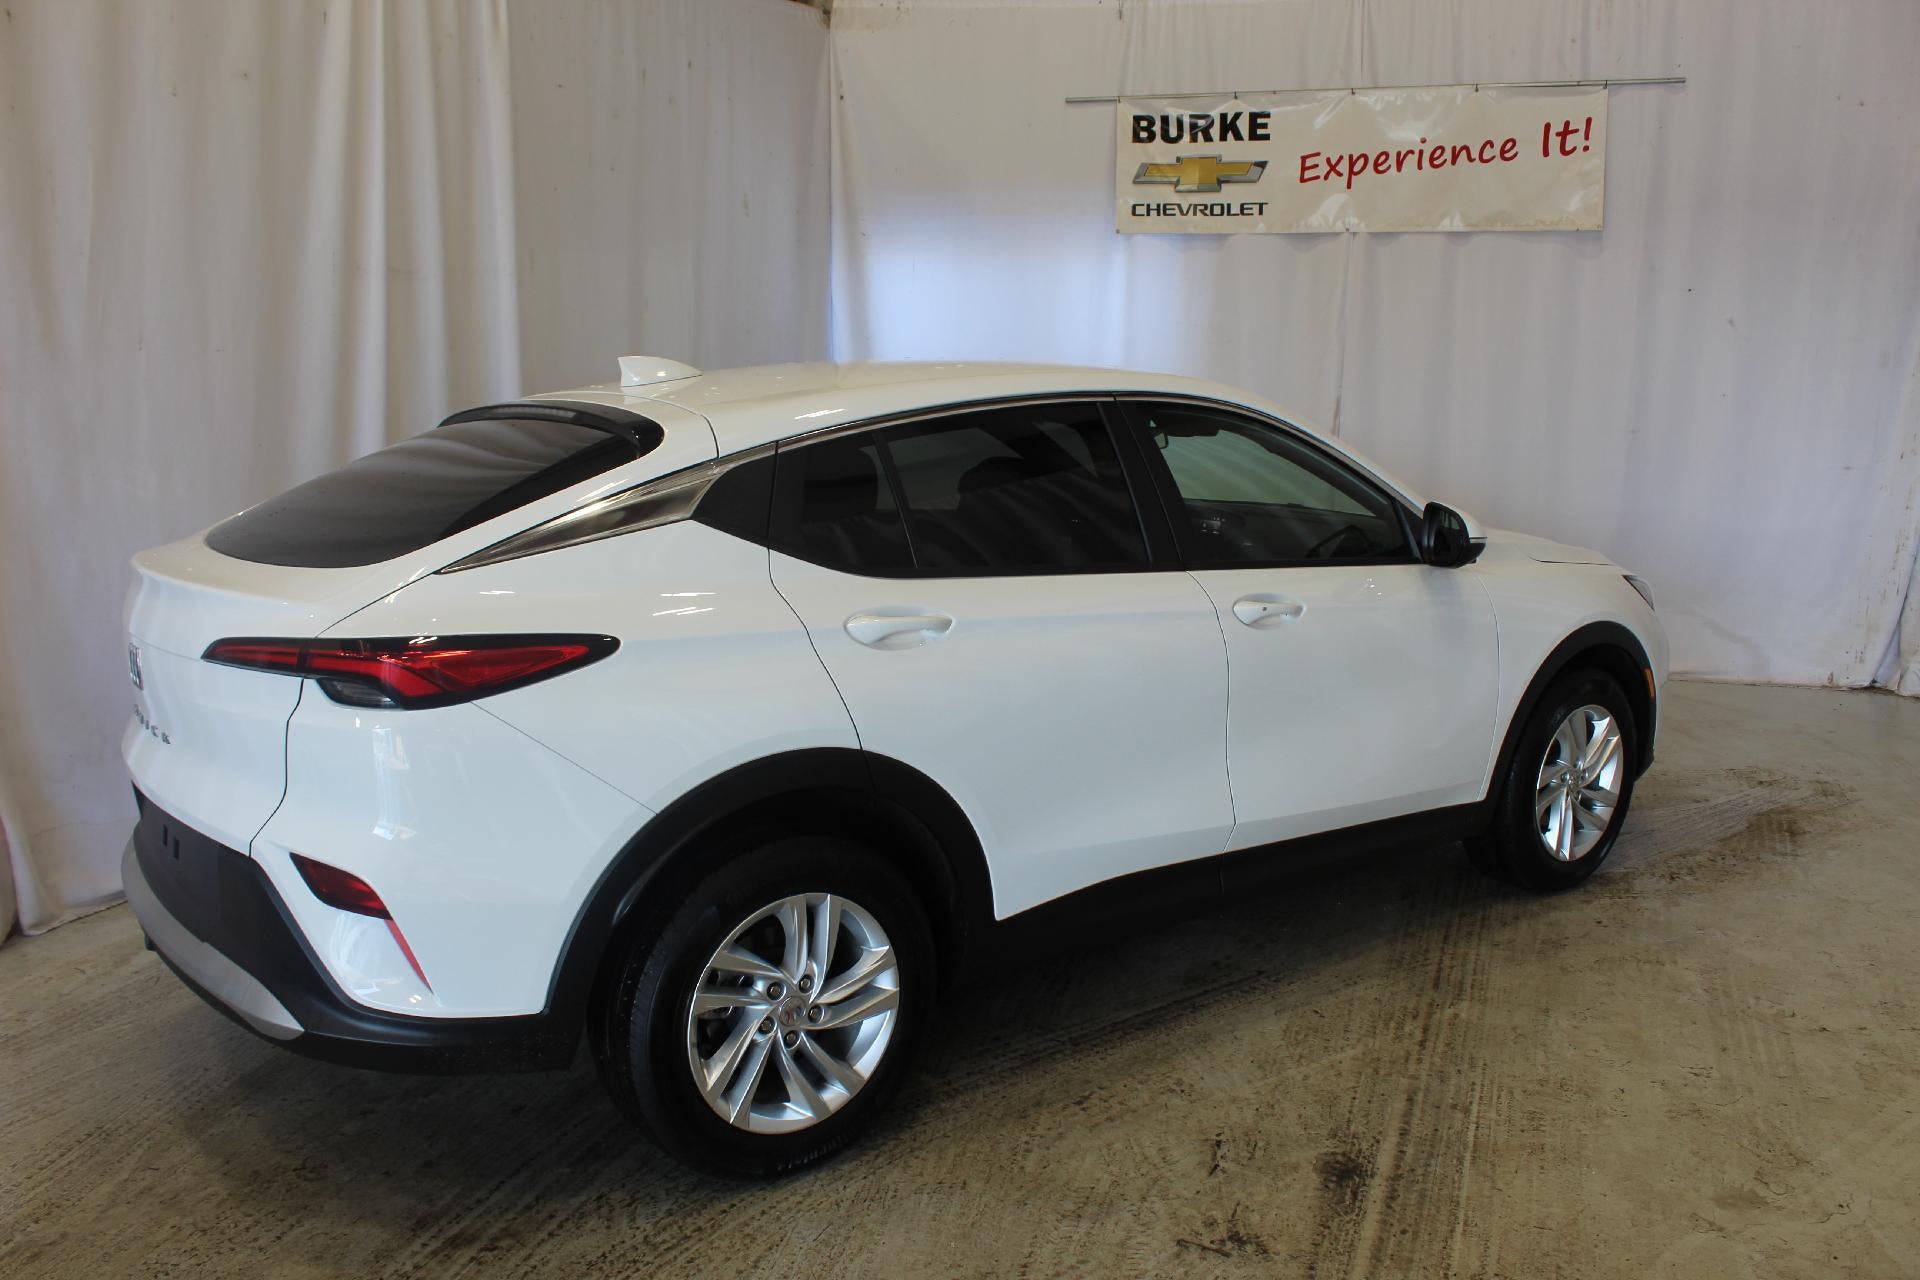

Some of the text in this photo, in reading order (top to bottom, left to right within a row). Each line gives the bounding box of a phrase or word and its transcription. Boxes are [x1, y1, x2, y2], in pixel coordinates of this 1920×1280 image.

[1132, 111, 1271, 144] BURKE
[1298, 116, 1593, 190] Experience It!
[1131, 202, 1268, 217] CHEVROLET
